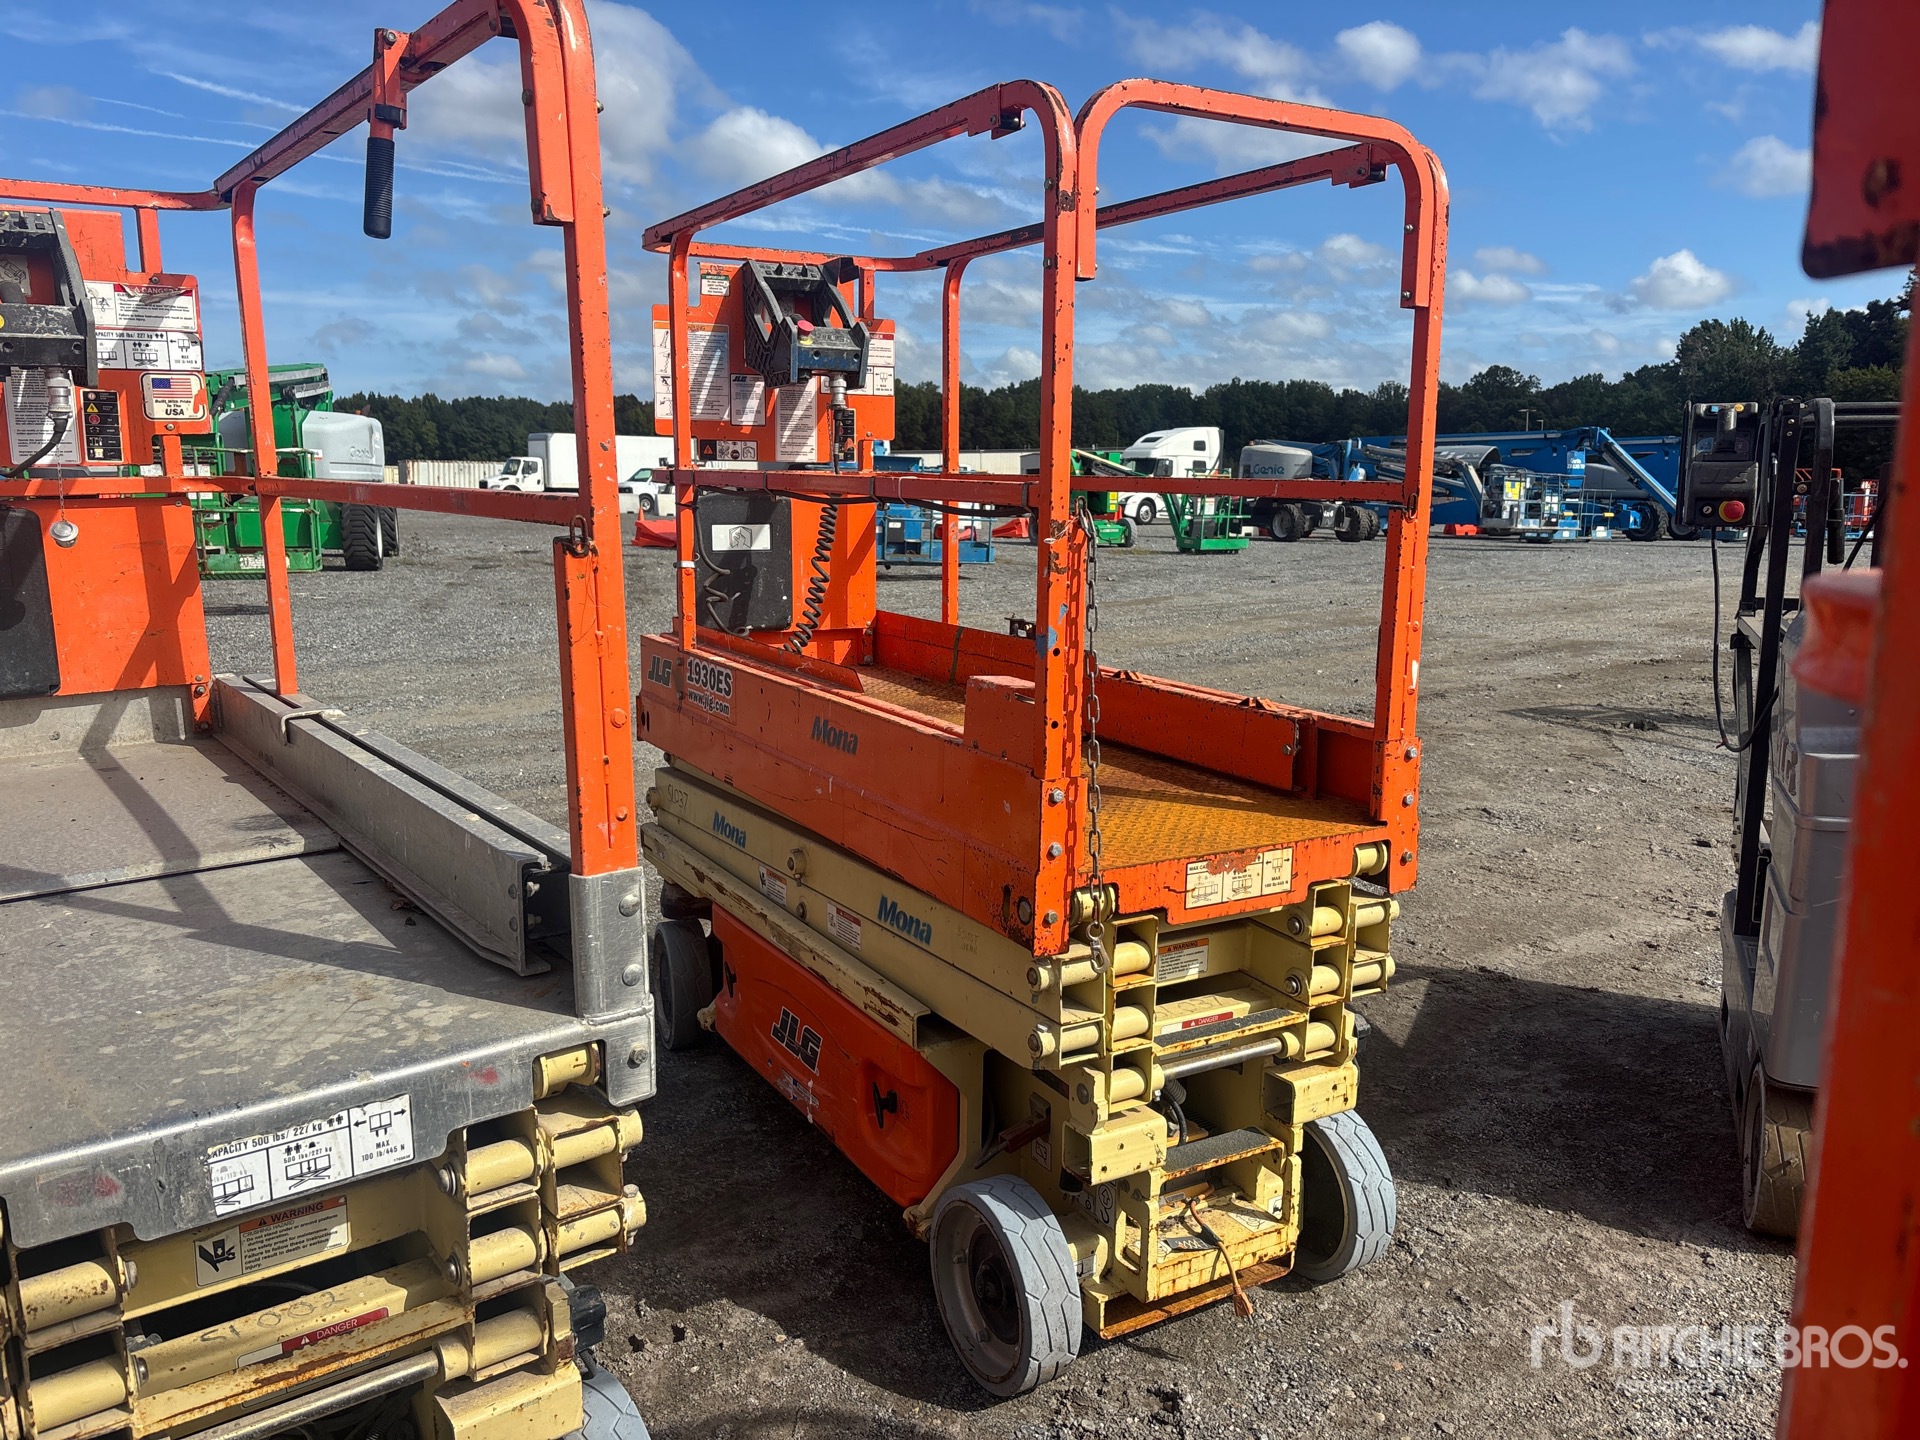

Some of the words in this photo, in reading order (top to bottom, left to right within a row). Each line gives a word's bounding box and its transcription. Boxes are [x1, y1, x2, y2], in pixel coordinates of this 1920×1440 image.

[165, 408, 185, 416] USA
[1253, 464, 1285, 475] Genie
[647, 655, 673, 688] JLG
[687, 656, 734, 699] 1930ES
[688, 688, 731, 717] www.jlg.com
[811, 715, 859, 755] Mona
[713, 810, 747, 849] Mona
[877, 894, 933, 945] Mona
[1198, 1016, 1219, 1025] DANGER
[770, 1006, 823, 1073] JLG
[252, 1136, 270, 1148] 500
[312, 1122, 323, 1133] kg
[375, 1139, 391, 1150] MAX
[283, 1155, 296, 1164] 500
[361, 1152, 374, 1162] 100
[271, 1202, 324, 1222] WARNING
[243, 1227, 272, 1238] CRUSHING
[273, 1220, 295, 1230] HAZARD
[316, 1318, 358, 1340] DANGER
